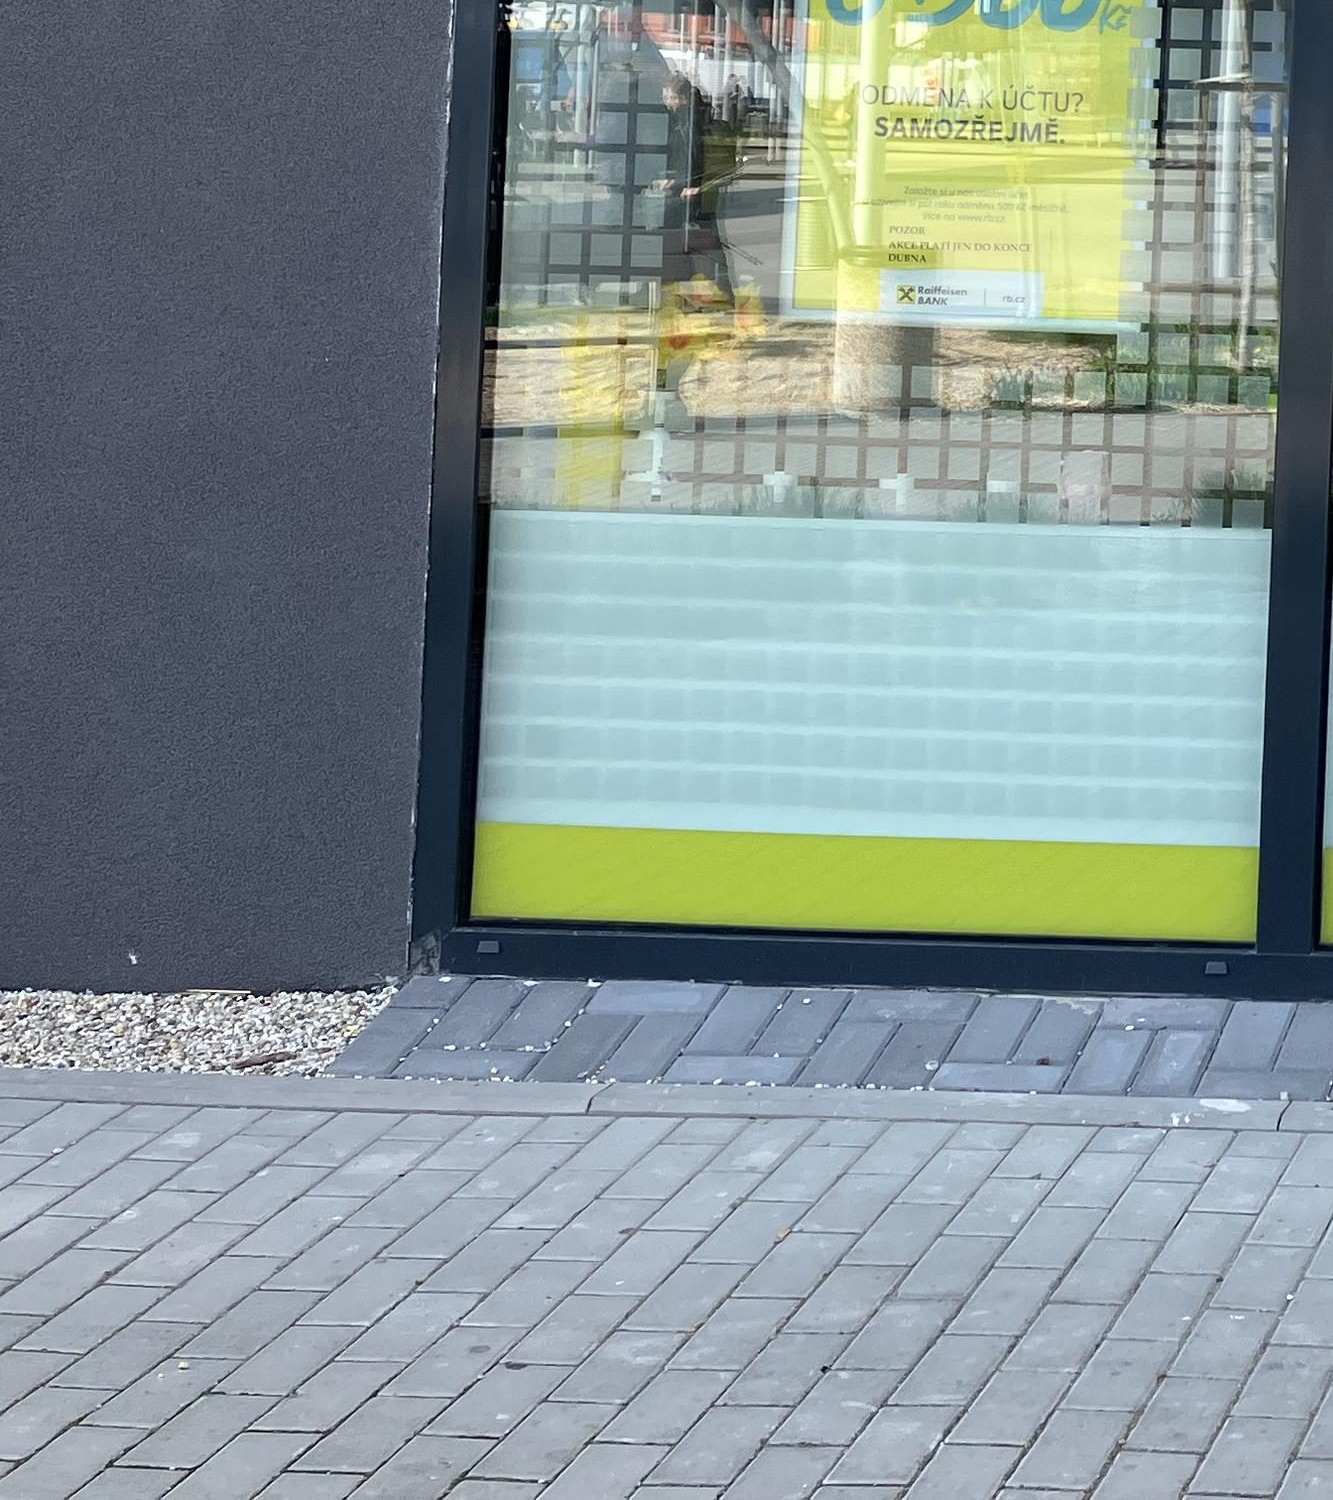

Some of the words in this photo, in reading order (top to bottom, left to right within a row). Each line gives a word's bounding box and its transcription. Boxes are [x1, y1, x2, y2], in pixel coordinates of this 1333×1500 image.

[980, 89, 993, 109] K
[1003, 84, 1084, 113] ÚČTU?
[874, 115, 1066, 145] SAMOZŘEJMĚ.
[890, 226, 926, 235] POZOR
[888, 253, 927, 263] DUBNA
[918, 286, 967, 296] Raiffeisen
[918, 297, 948, 306] BANK
[1002, 295, 1026, 304] rb.cz
